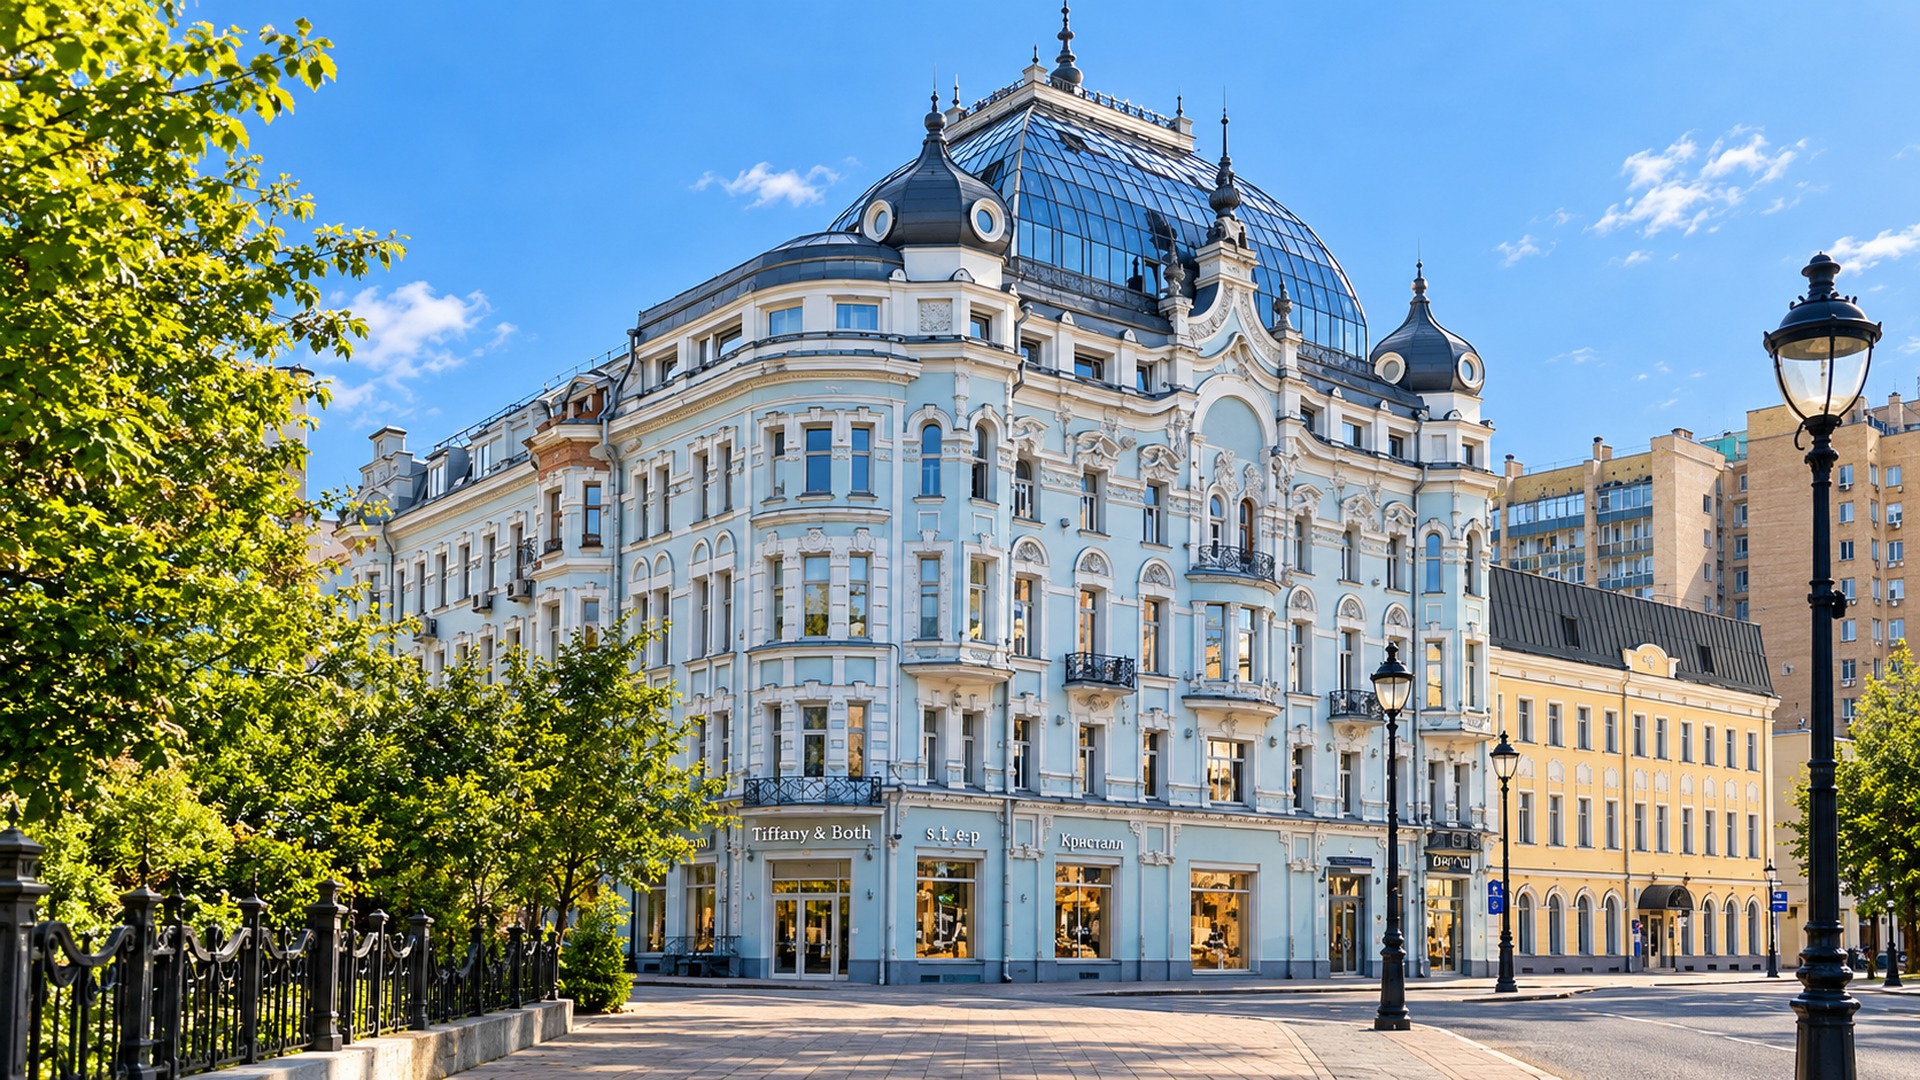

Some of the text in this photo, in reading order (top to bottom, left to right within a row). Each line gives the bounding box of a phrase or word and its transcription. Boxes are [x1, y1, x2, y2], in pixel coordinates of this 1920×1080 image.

[751, 824, 872, 844] Tiffany & Both
